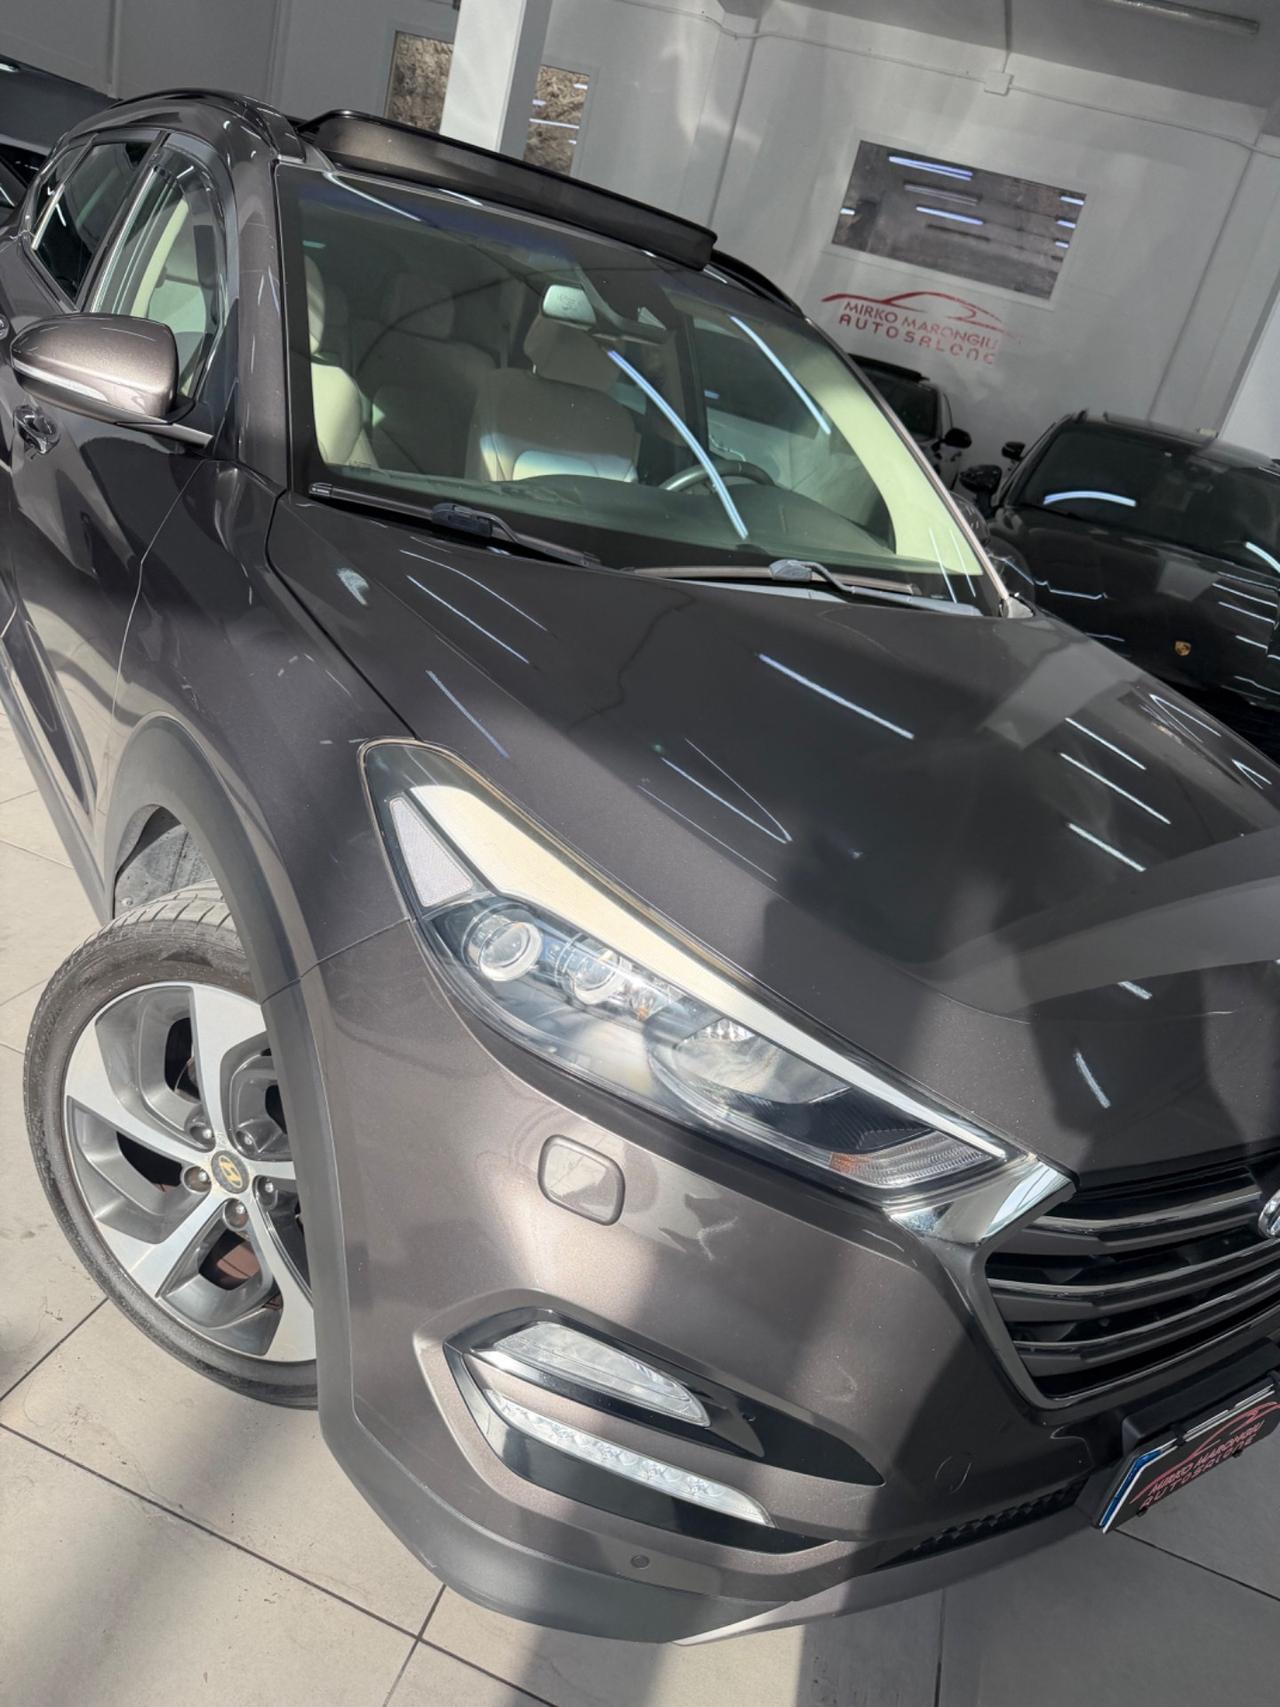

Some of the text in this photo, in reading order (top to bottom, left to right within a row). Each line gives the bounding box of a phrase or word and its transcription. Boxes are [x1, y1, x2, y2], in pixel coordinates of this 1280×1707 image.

[839, 313, 996, 364] AUTOSALONE
[843, 301, 999, 350] MIRKO MARONGIU
